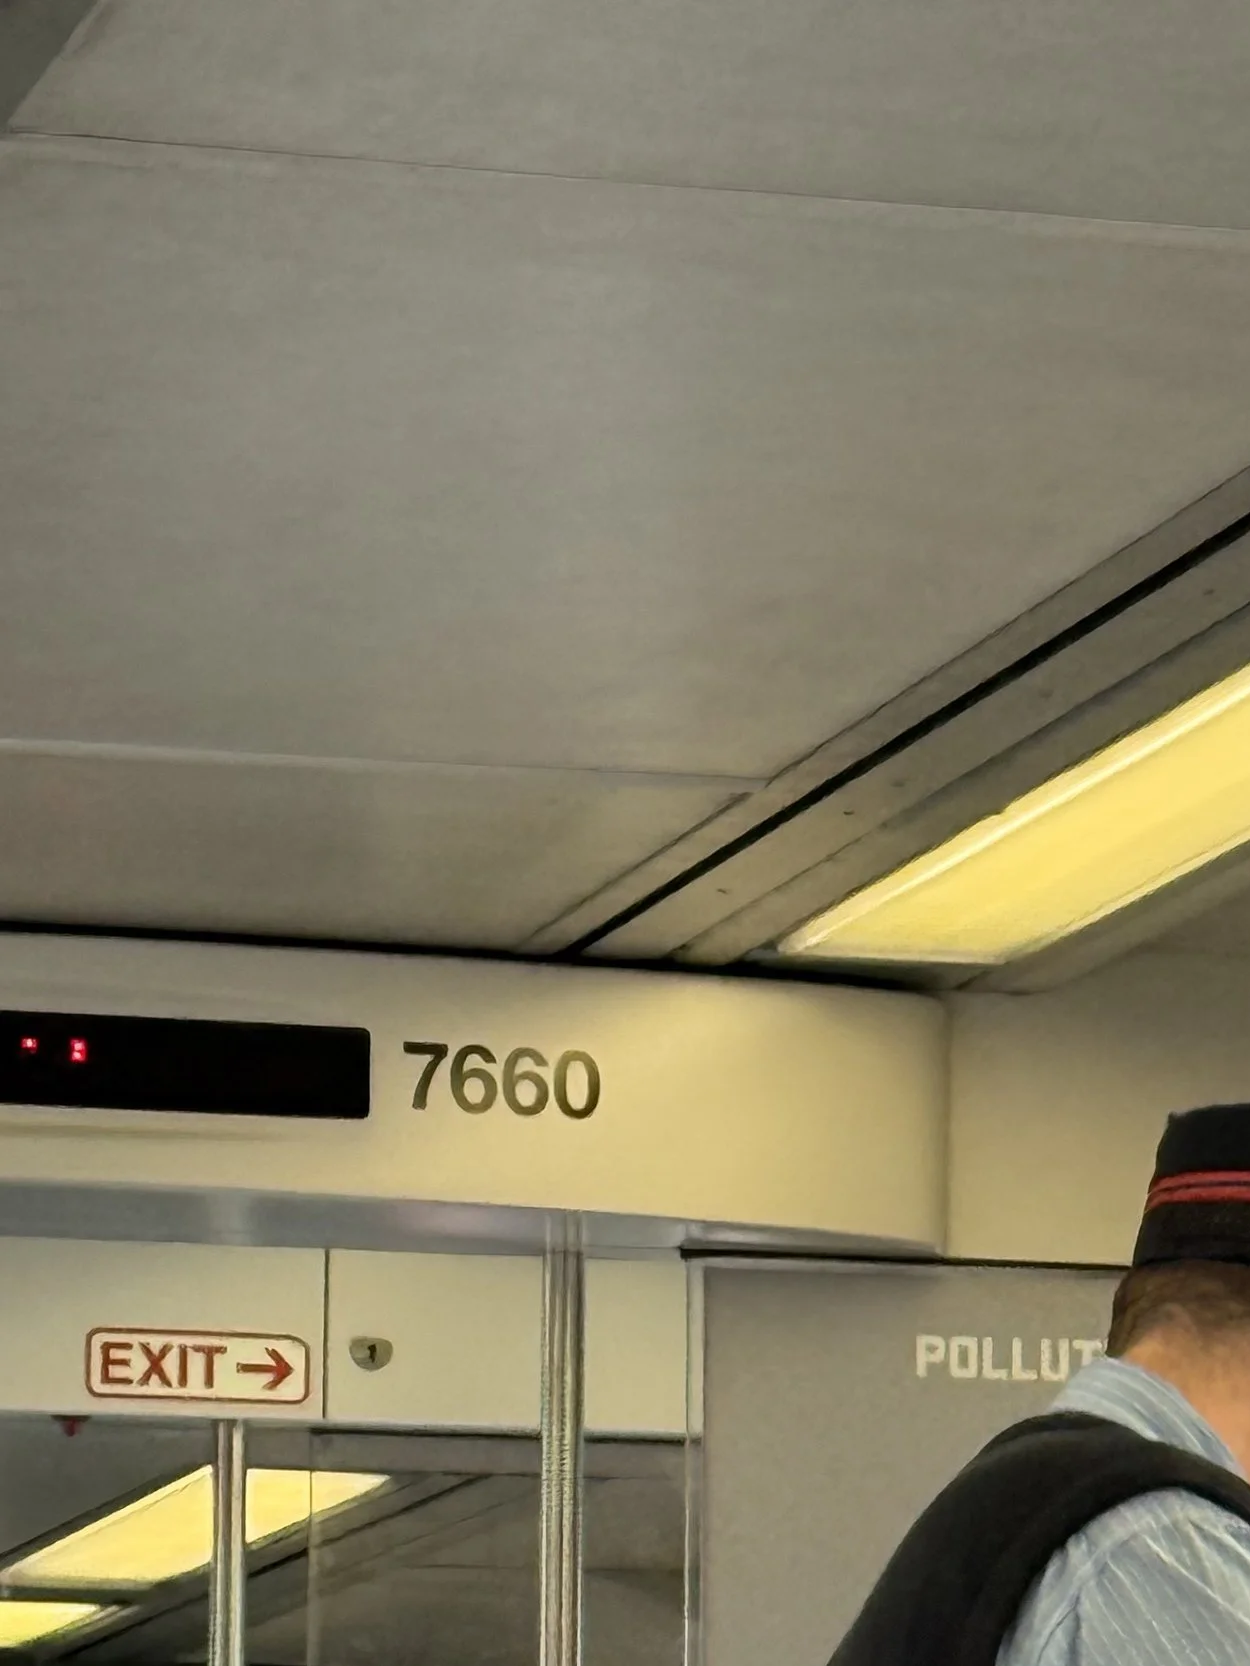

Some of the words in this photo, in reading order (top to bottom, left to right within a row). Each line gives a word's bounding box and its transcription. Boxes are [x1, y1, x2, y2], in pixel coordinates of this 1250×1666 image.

[403, 1042, 600, 1119] 7660
[99, 1341, 227, 1389] EXIT
[915, 1334, 1108, 1381] POLLUT
